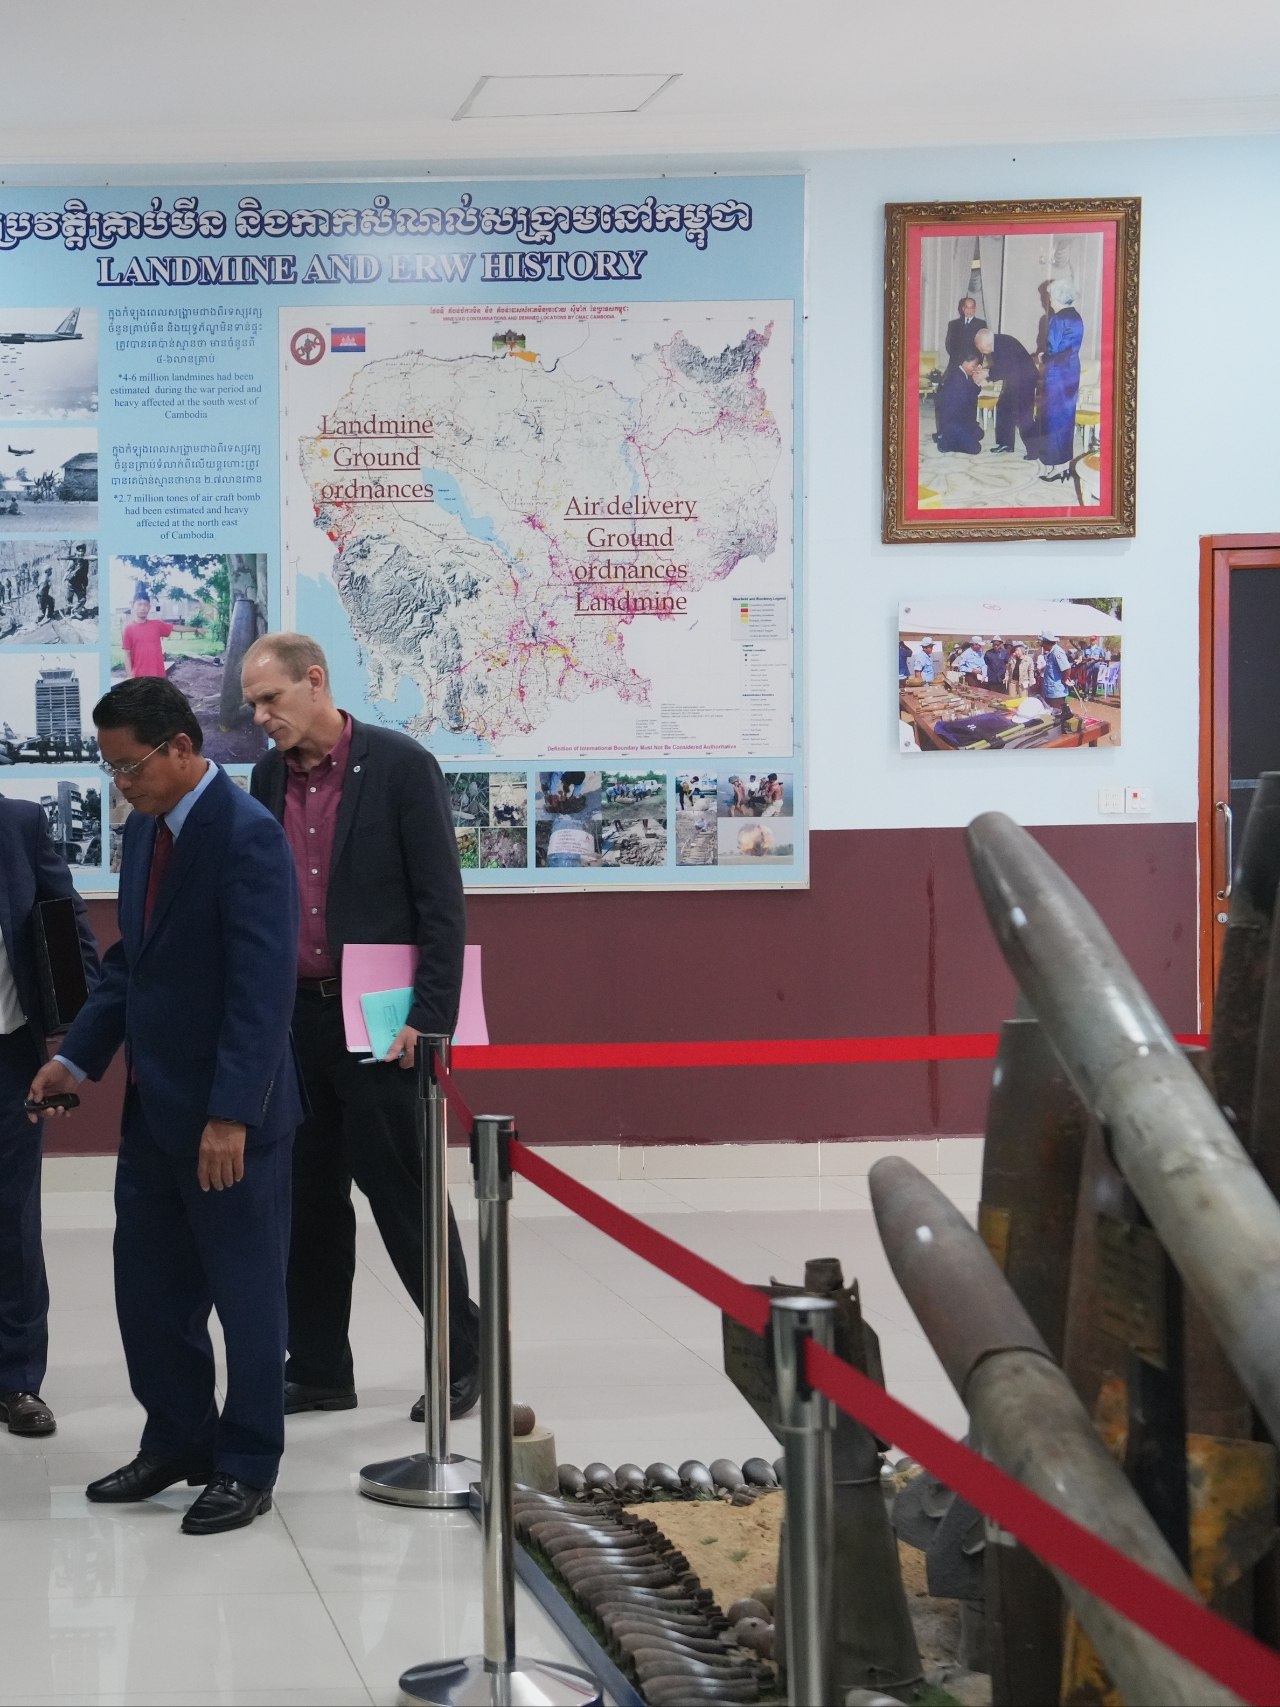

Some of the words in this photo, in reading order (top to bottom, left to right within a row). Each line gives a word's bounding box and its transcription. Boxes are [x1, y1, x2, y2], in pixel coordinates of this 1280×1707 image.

[235, 192, 753, 250] និងកាកសំណល់សង្គ្រាមនៅកម្ពុជា
[96, 254, 298, 287] LANDMINE
[301, 252, 383, 285] AND
[388, 251, 474, 283] ERW
[480, 250, 648, 283] HISTORY
[139, 373, 170, 382] million
[172, 372, 215, 381] landmines
[216, 372, 233, 381] had
[234, 372, 254, 381] been
[110, 385, 150, 395] estimated
[154, 385, 182, 395] during
[184, 385, 197, 394] the
[217, 385, 244, 396] period
[246, 384, 262, 393] and
[114, 399, 139, 409] heavy
[141, 398, 175, 407] affected
[187, 398, 200, 406] the
[202, 398, 225, 406] south
[249, 397, 259, 406] of
[164, 410, 208, 419] Cambodia
[321, 414, 434, 435] Landmine
[333, 445, 421, 467] Ground
[134, 493, 164, 503] million
[191, 493, 200, 502] of
[215, 493, 235, 501] craft
[236, 492, 261, 501] bomb
[321, 478, 435, 500] ordnances
[125, 507, 140, 515] had
[142, 506, 162, 515] been
[164, 506, 204, 515] estimated
[206, 506, 222, 514] and
[224, 506, 249, 516] heavy
[564, 495, 601, 515] Air
[607, 495, 698, 521] delivery
[136, 518, 170, 527] affected
[182, 518, 195, 527] the
[197, 518, 219, 526] north
[160, 531, 170, 540] of
[171, 531, 214, 540] Cambodia
[587, 526, 674, 547] Ground
[574, 559, 688, 580] ordnances
[576, 591, 688, 612] Landmine
